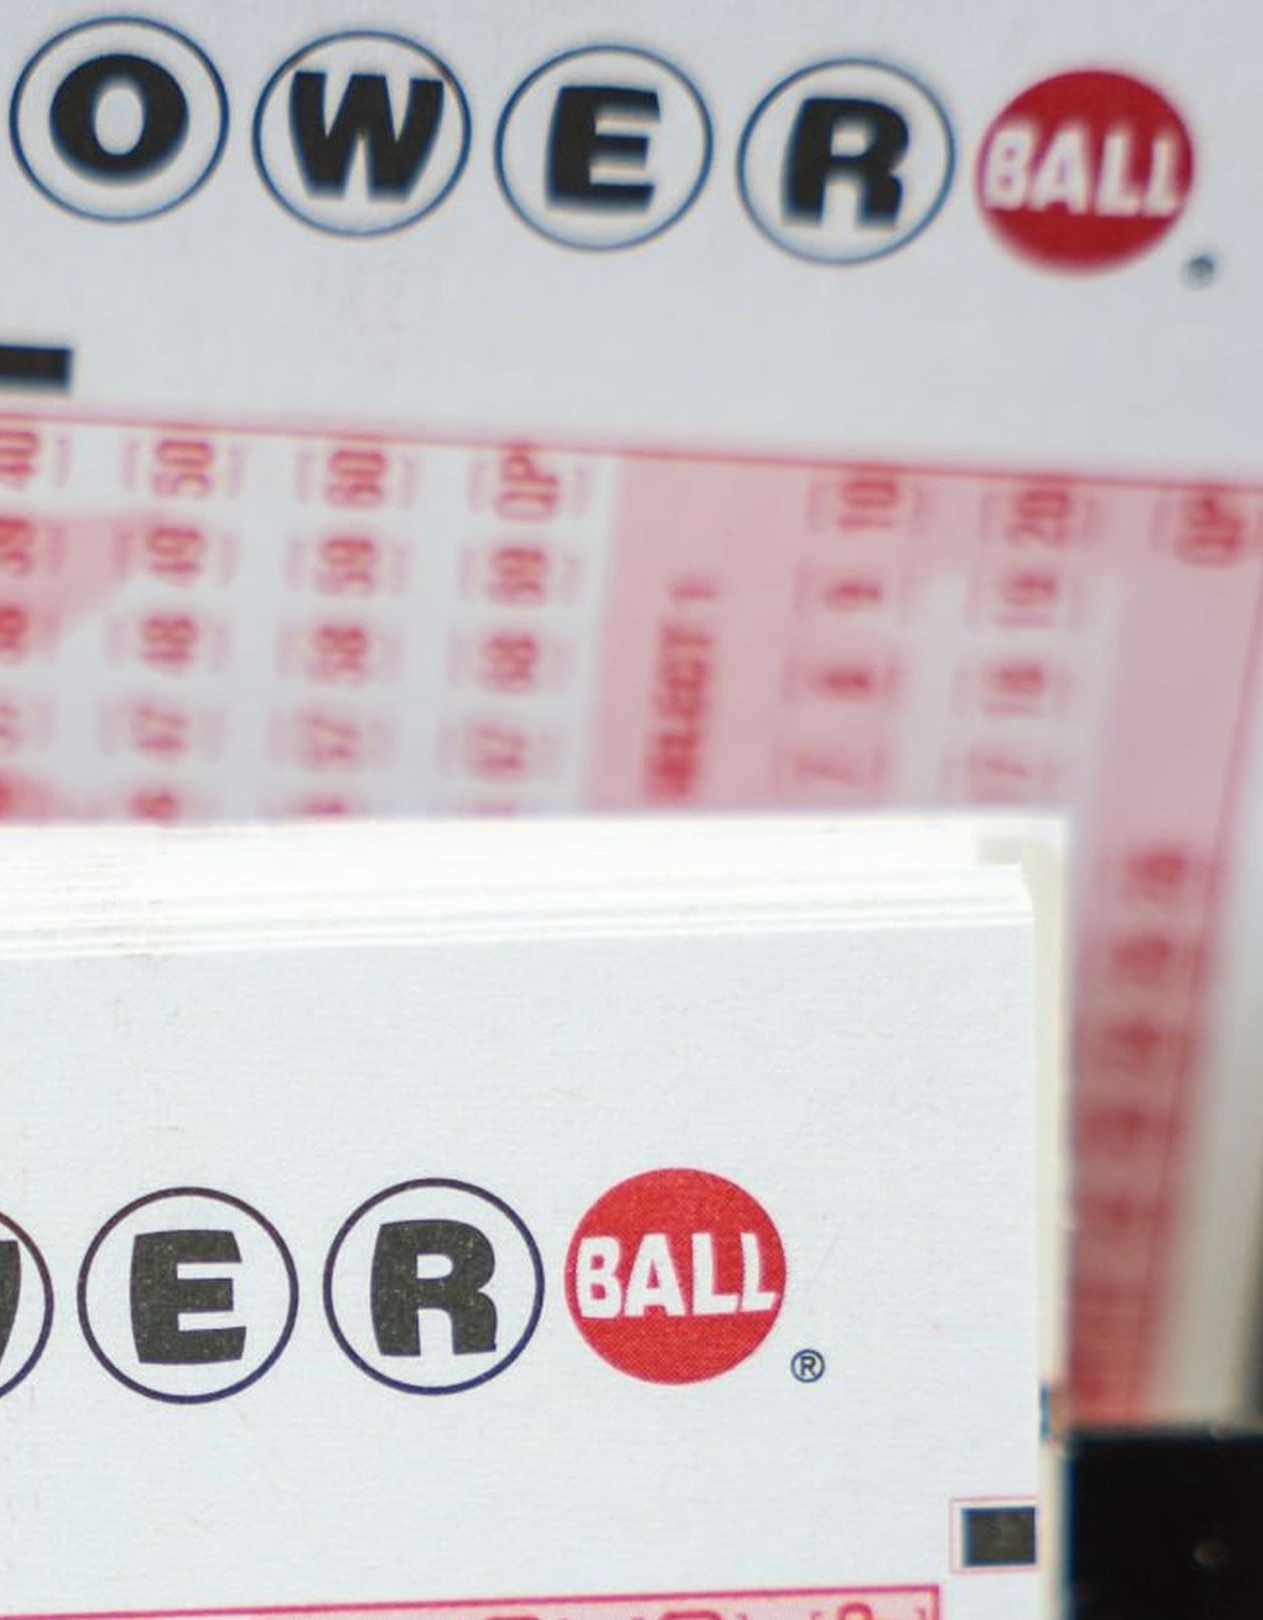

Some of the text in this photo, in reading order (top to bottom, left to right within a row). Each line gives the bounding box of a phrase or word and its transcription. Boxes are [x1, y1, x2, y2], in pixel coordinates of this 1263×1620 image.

[981, 116, 1183, 218] BALL
[156, 438, 211, 496] 50
[328, 446, 385, 506] 60
[495, 445, 557, 519] QP
[838, 479, 898, 533] 10
[1007, 486, 1072, 545] 20
[148, 523, 203, 582] 49
[319, 535, 376, 594] 59
[576, 1230, 777, 1320] BALL
